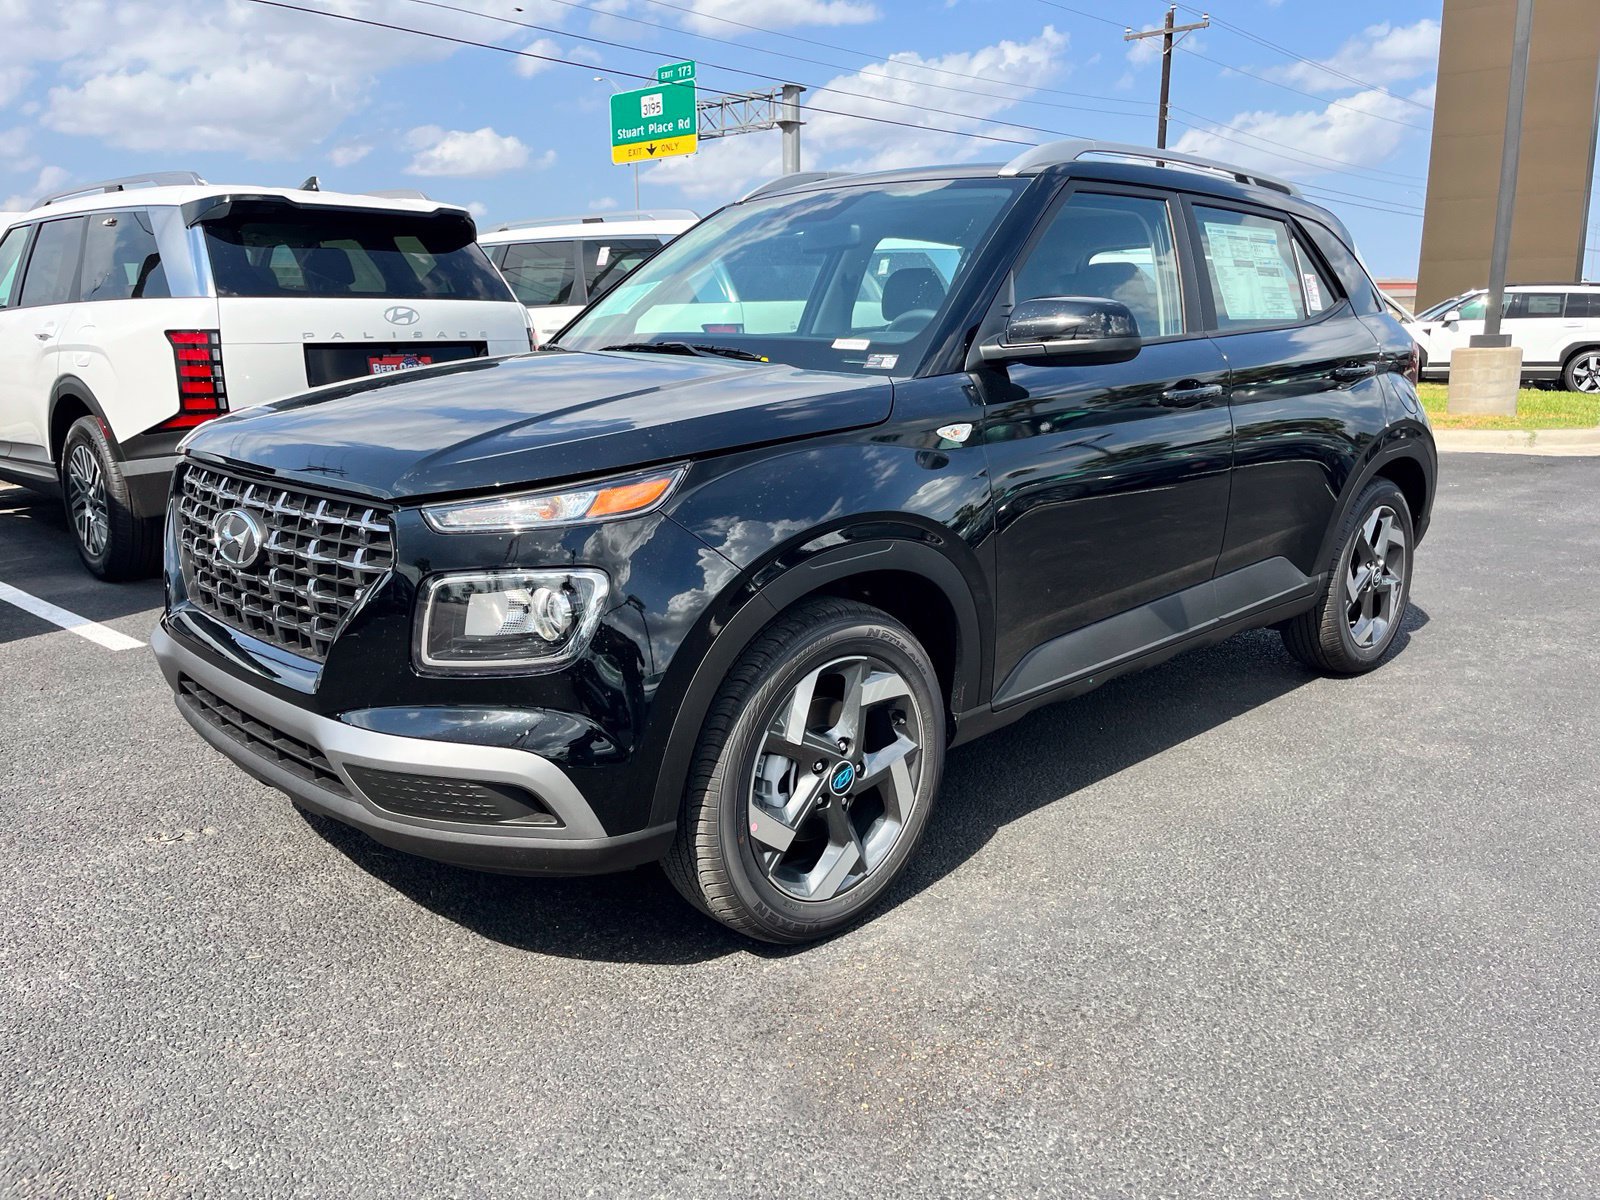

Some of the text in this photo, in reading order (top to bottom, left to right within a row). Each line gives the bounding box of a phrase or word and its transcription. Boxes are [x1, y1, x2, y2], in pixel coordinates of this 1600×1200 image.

[661, 65, 691, 79] EXIT 173
[643, 102, 661, 116] 3195
[617, 117, 690, 139] Stuart Place Rd
[628, 142, 679, 157] EXIT ONLY
[302, 331, 488, 340] PALISADE
